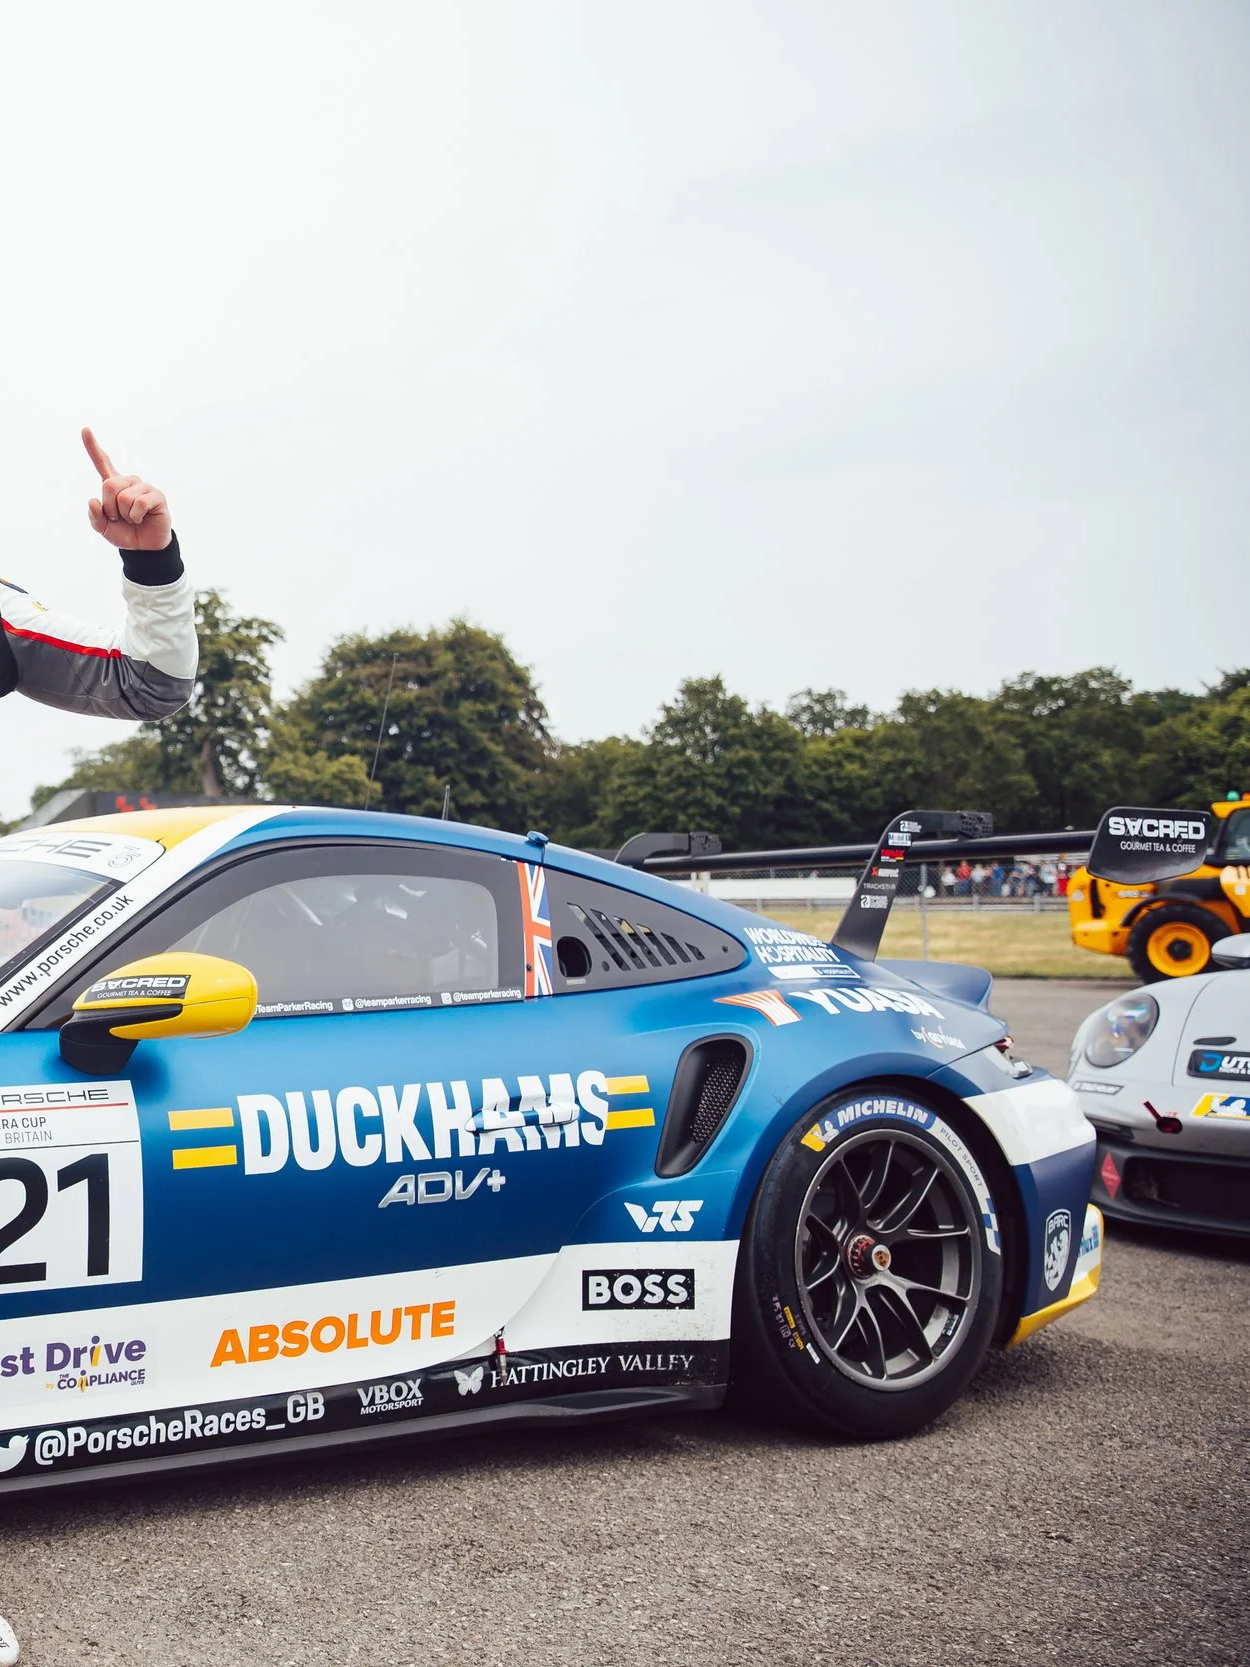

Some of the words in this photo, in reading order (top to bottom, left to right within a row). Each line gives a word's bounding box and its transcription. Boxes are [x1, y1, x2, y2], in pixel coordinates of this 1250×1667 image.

[1120, 841, 1152, 851] GOURMET
[1153, 842, 1165, 851] TEA
[1172, 844, 1196, 853] COFFEE
[744, 927, 827, 948] WORLDWIDE
[754, 945, 841, 964] HOSPITALITY
[97, 990, 127, 999] GOURMET
[788, 987, 945, 1020] YUASA
[22, 1116, 47, 1128] CUP
[236, 1069, 609, 1176] DUCKHAMS
[837, 1099, 928, 1127] MICHELIN
[5, 1130, 53, 1144] BRITAIN
[940, 1128, 962, 1152] PILOT
[962, 1153, 983, 1188] SPORT
[378, 1167, 507, 1209] ADV+
[1048, 1214, 1069, 1235] BARC
[588, 1274, 689, 1305] BOSS
[209, 1300, 456, 1368] ABSOLUTE
[45, 1335, 147, 1373] Drive
[45, 1382, 54, 1390] by
[490, 1356, 612, 1389] HATTINGLEY
[617, 1355, 695, 1372] VALLEY
[356, 1378, 423, 1407] VBOX
[360, 1397, 425, 1415] MOTORSPORT
[34, 1391, 325, 1466] @PorscheRaces_GB
